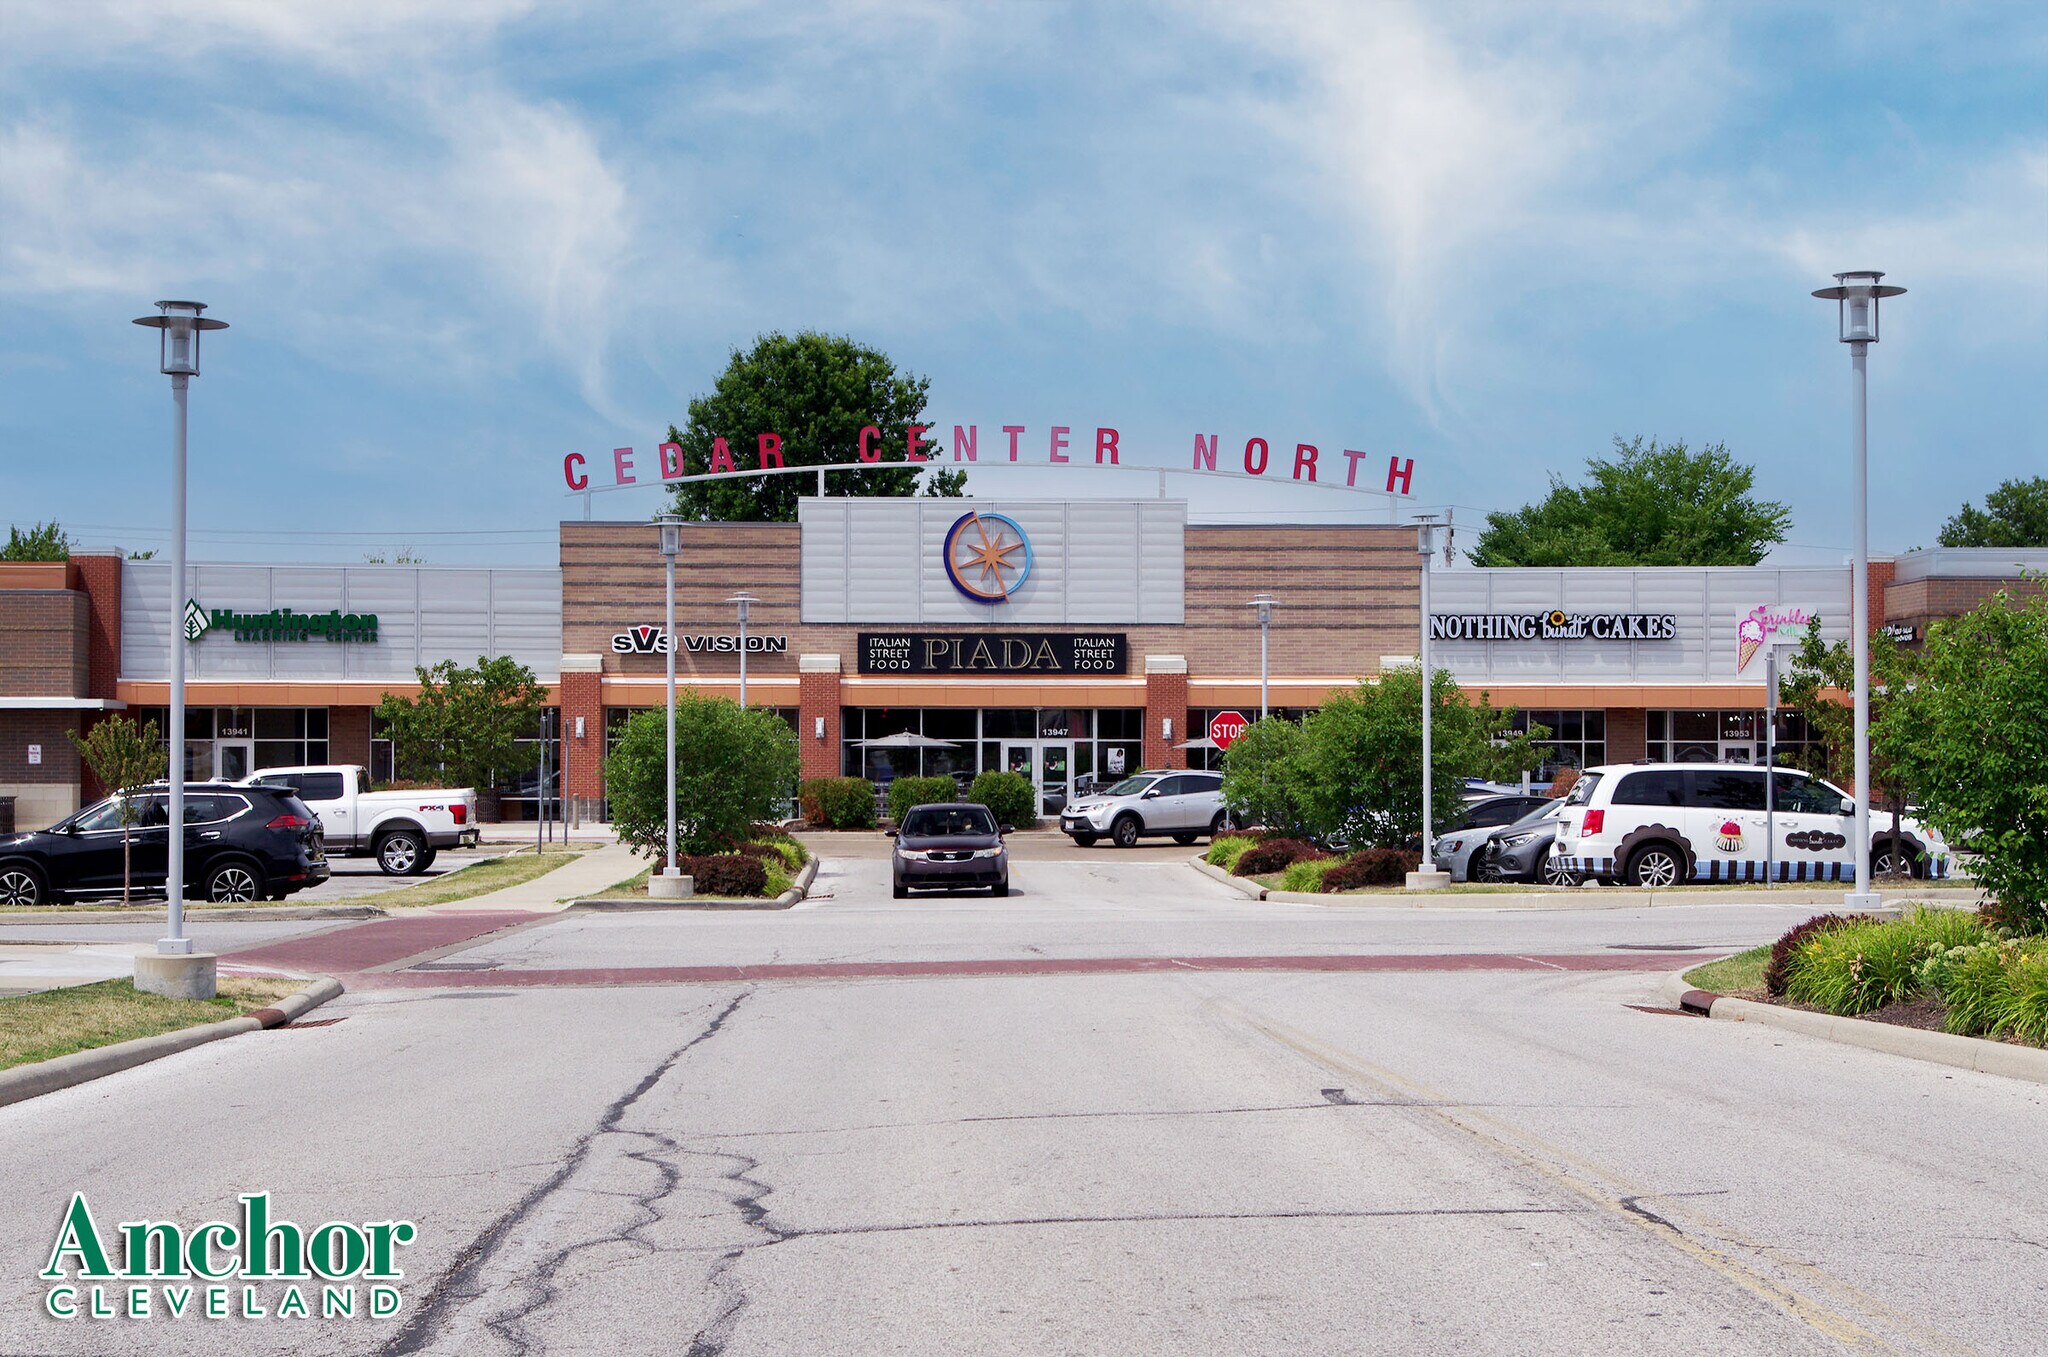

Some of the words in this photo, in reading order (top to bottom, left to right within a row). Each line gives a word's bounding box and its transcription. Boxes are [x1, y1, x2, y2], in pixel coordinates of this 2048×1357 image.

[564, 432, 784, 491] CEDAR
[858, 425, 1119, 465] CENTER
[1192, 433, 1414, 495] NORTH
[211, 608, 378, 635] Huntington
[1430, 615, 1537, 639] NOTHING
[1539, 611, 1591, 639] bundt
[1591, 615, 1678, 639] CAKES
[234, 631, 308, 643] LEARNING
[326, 631, 378, 643] CENTER
[683, 635, 787, 652] VISION
[869, 638, 911, 648] ITALIAN
[1073, 638, 1115, 648] ITALIAN
[869, 649, 910, 659] STREET
[921, 637, 1062, 670] PIADA
[1073, 649, 1115, 659] STREET
[869, 659, 911, 670] FOOD
[1074, 659, 1115, 670] FOOD
[222, 728, 248, 736] 13941
[1042, 728, 1069, 736] 13947
[1212, 723, 1246, 739] STOP
[1723, 729, 1750, 738] 13953
